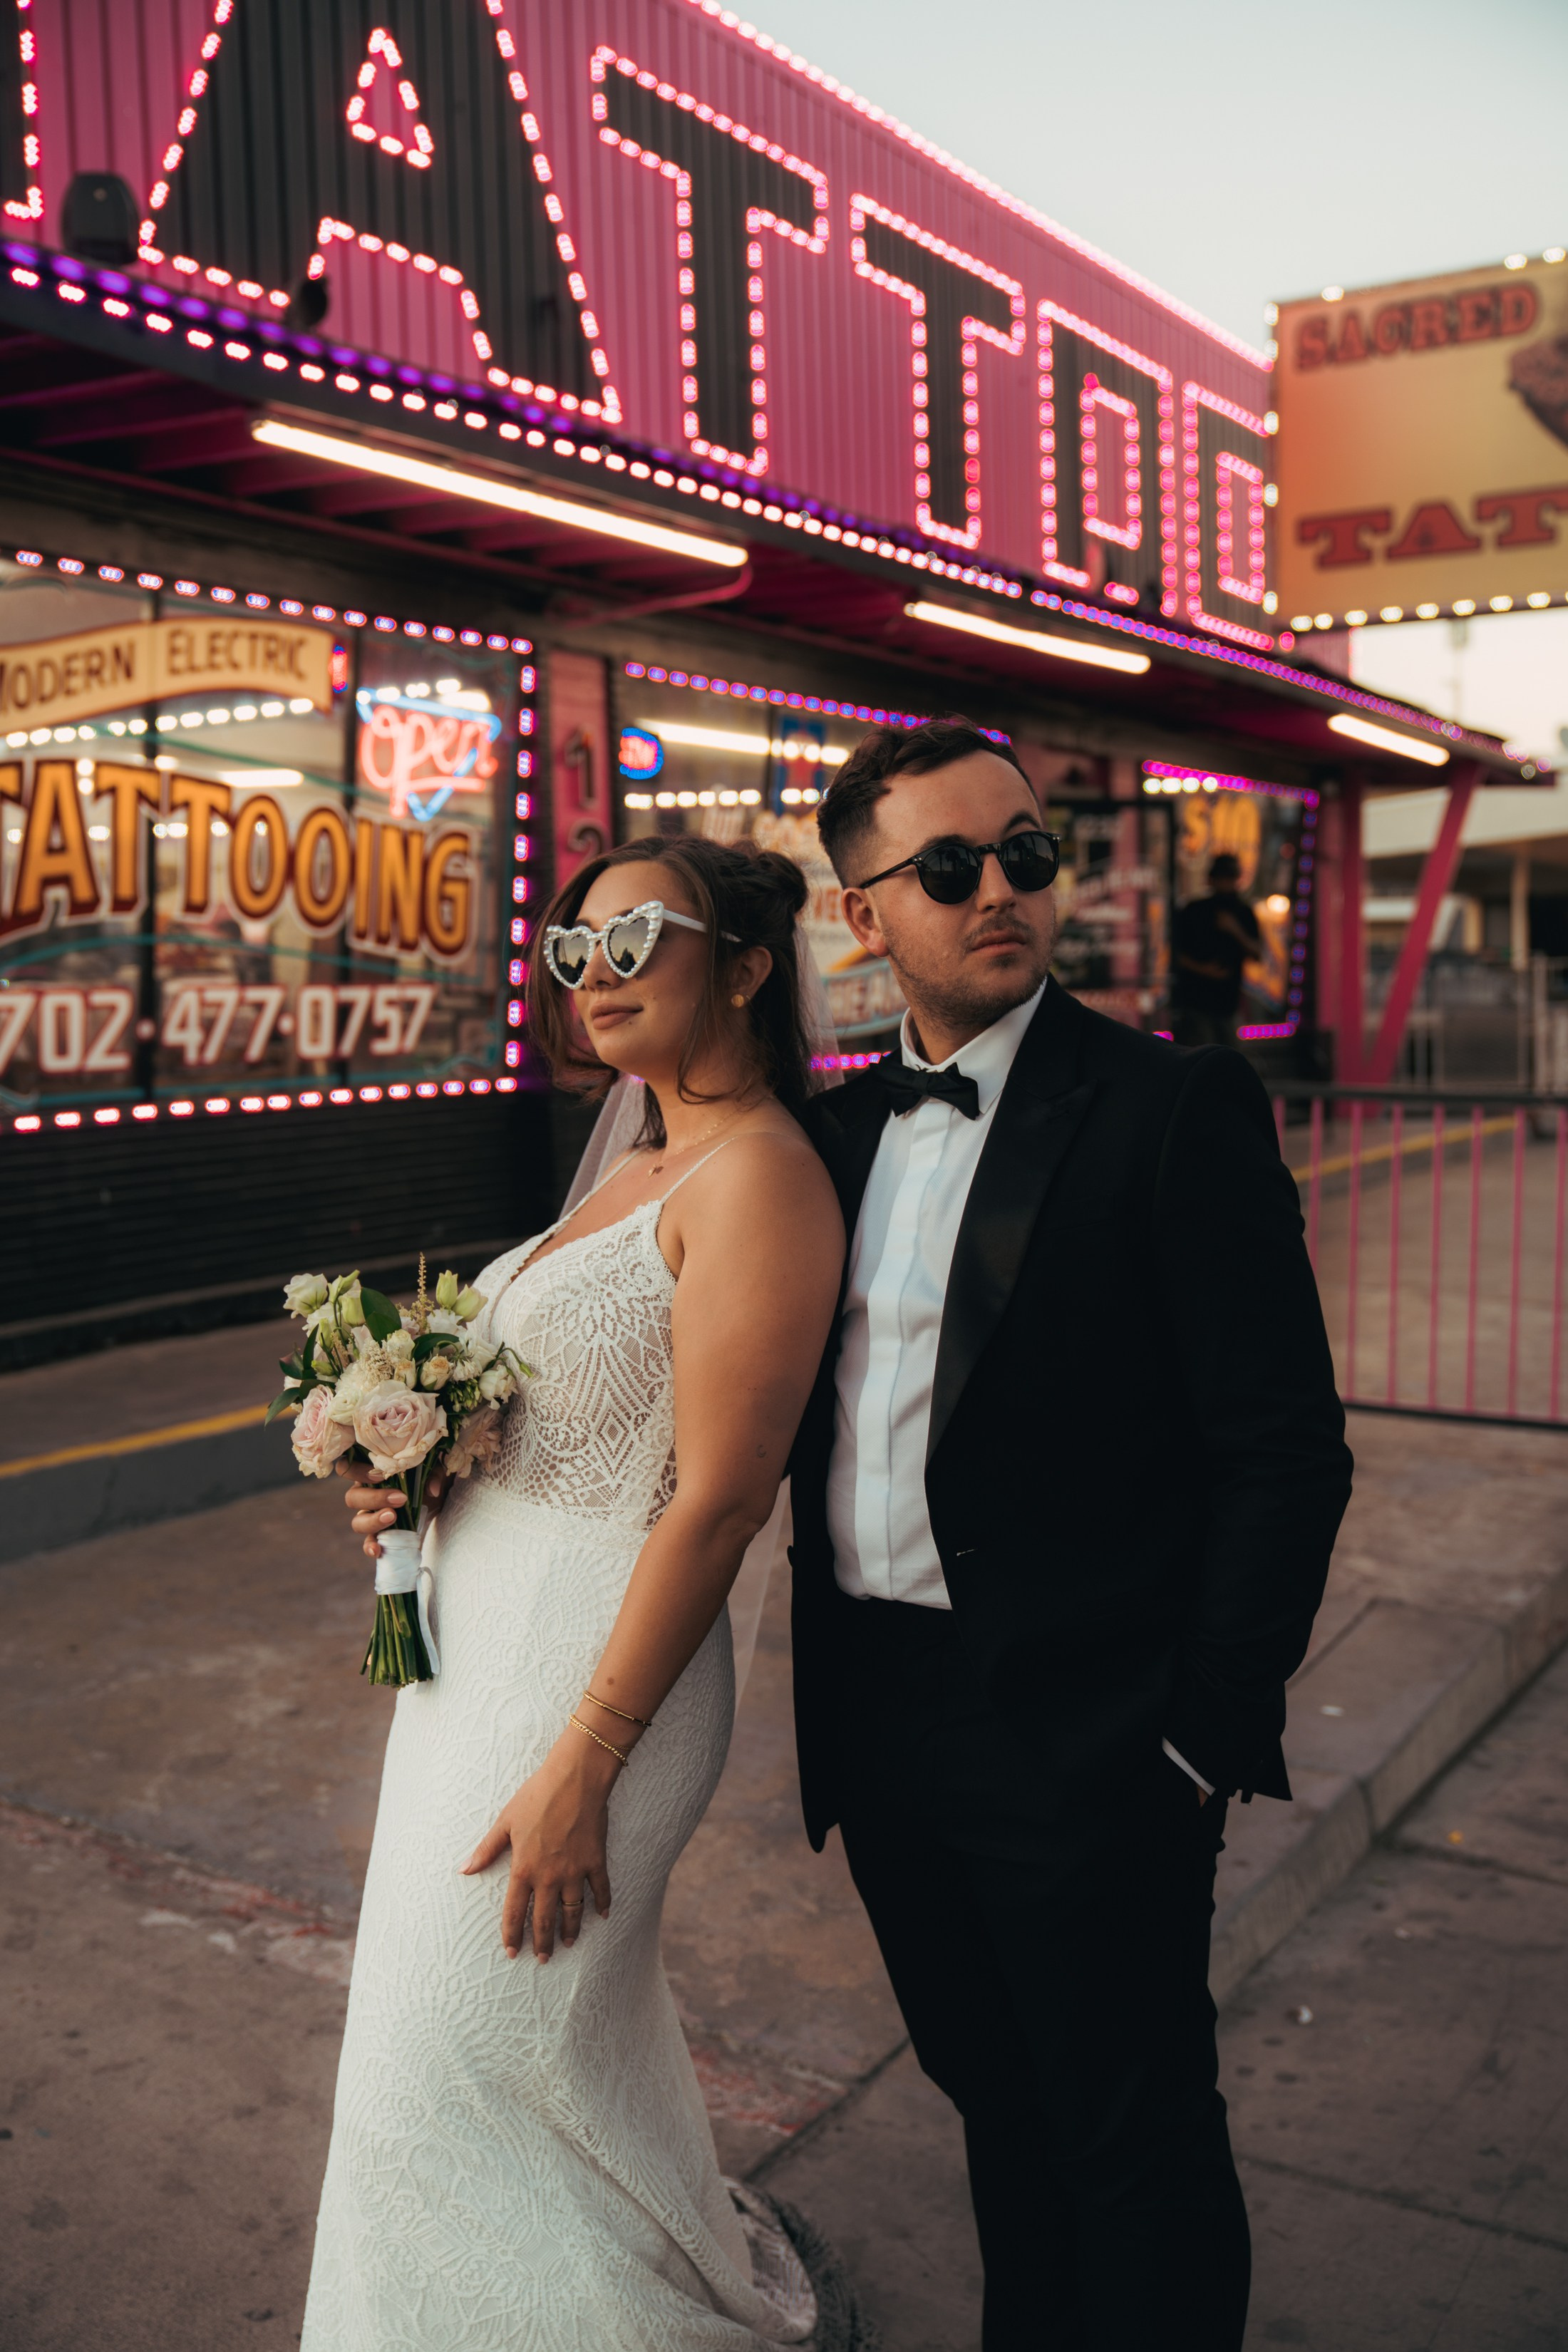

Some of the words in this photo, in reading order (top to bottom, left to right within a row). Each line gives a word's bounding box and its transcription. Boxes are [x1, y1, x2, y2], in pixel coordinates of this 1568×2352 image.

[0, 0, 1277, 651] ATTOO
[1297, 281, 1539, 372] SACRED
[0, 640, 137, 715] ODERN
[167, 627, 309, 681] ELECTRIC
